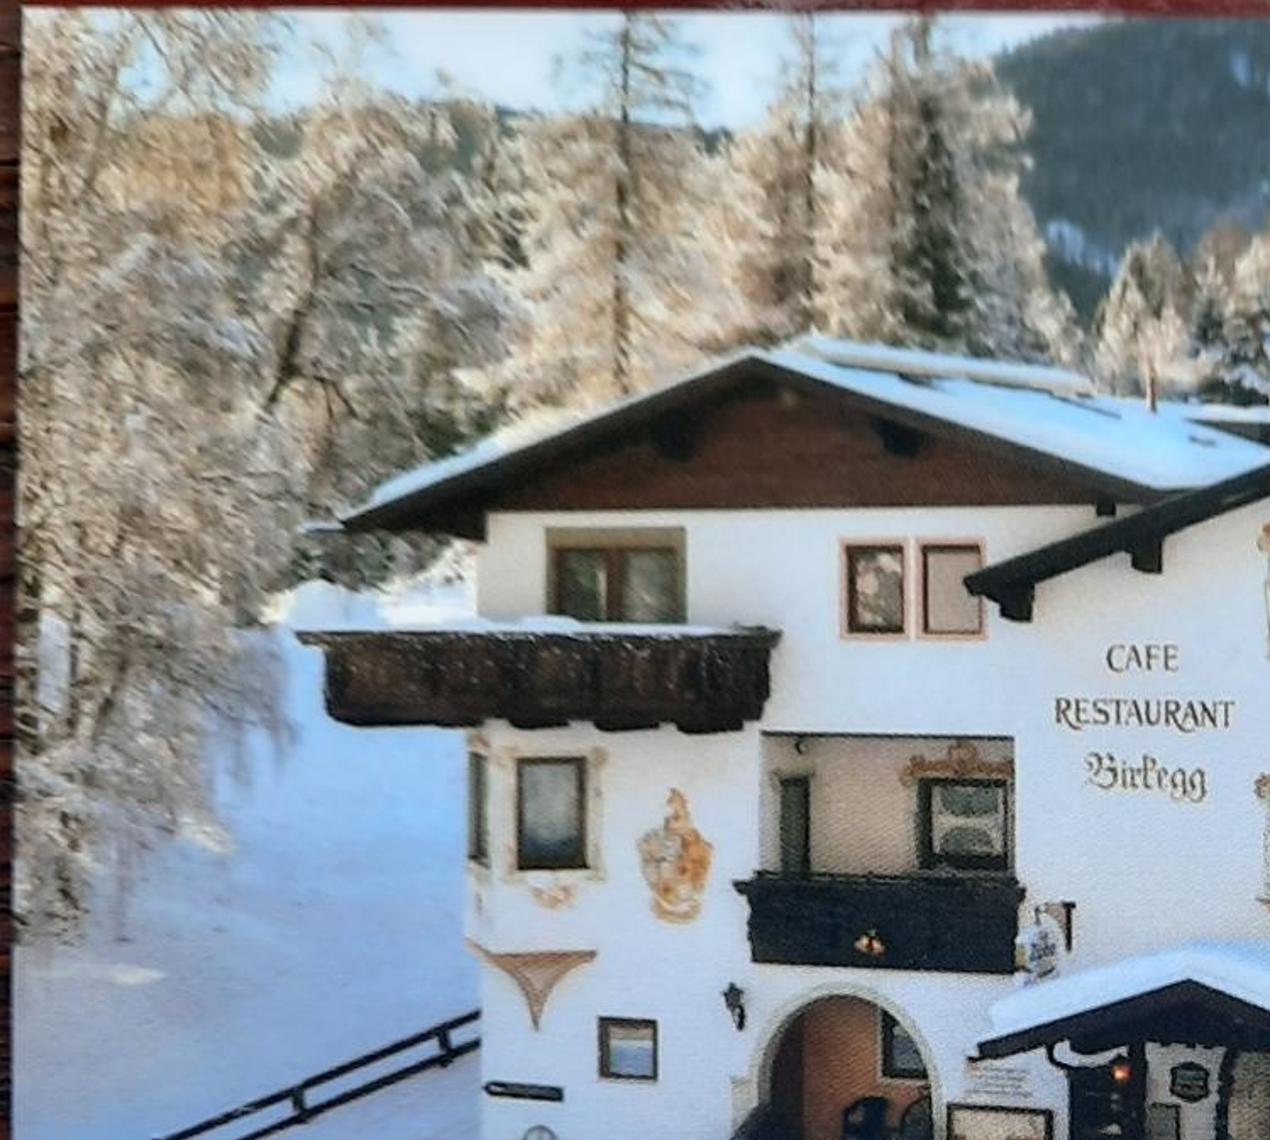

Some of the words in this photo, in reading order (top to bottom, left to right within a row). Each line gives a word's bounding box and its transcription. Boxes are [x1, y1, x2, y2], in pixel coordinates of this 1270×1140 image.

[1106, 644, 1179, 673] CAFE
[1055, 697, 1236, 733] RESTAURANT
[1084, 752, 1208, 803] Birkegg
